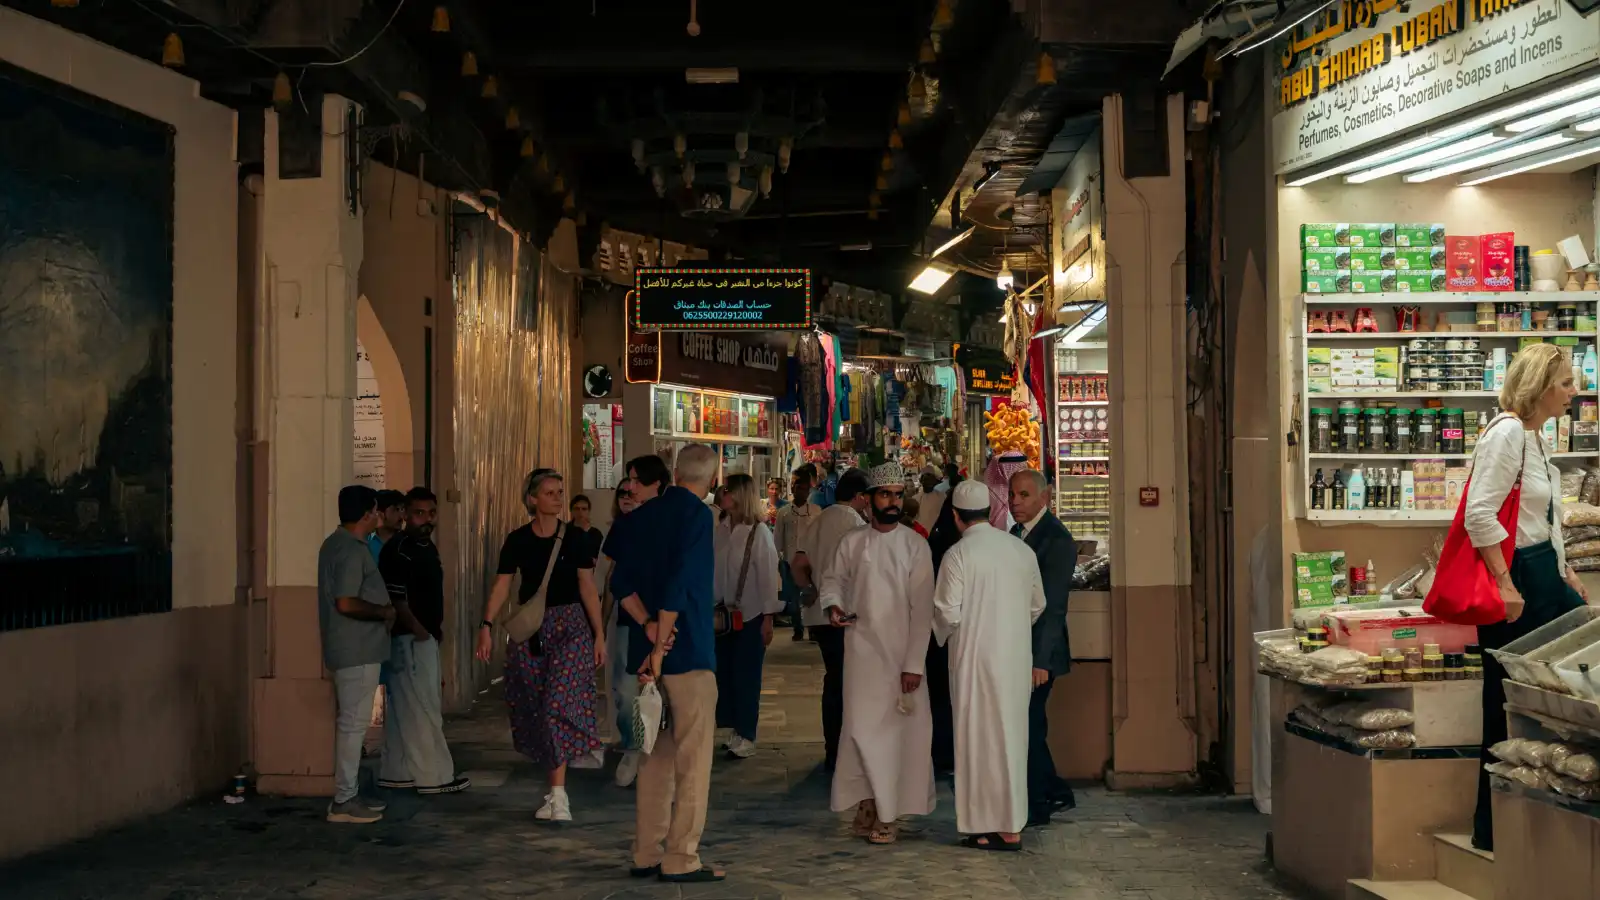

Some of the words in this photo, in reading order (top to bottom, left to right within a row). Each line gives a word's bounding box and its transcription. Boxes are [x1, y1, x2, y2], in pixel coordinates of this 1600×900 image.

[1521, 2, 1562, 40] العطور
[1281, 63, 1313, 105] ABU
[1319, 32, 1385, 89] SHIHAB
[1391, 0, 1458, 56] LUBAN
[1443, 25, 1515, 65] ومستحضرات
[1403, 50, 1438, 87] التجميل
[1299, 123, 1341, 151] Perfumes,
[1344, 101, 1396, 133] Cosmetics,
[1398, 76, 1453, 112] Decorative
[1456, 63, 1491, 90] Soaps
[1495, 48, 1516, 74] and
[1520, 34, 1563, 64] Incens
[1334, 86, 1358, 112] الزينة
[1362, 72, 1400, 104] وصابون
[1300, 100, 1332, 130] والبخور
[643, 277, 670, 289] للأفضل
[784, 278, 803, 289] كونوا
[683, 311, 763, 320] 0625500229120002
[697, 300, 711, 310] بنك
[745, 300, 772, 310] حساب
[628, 343, 658, 354] Coffee
[632, 356, 654, 367] Shop
[682, 332, 714, 361] COFFEE
[716, 337, 741, 367] SHOP
